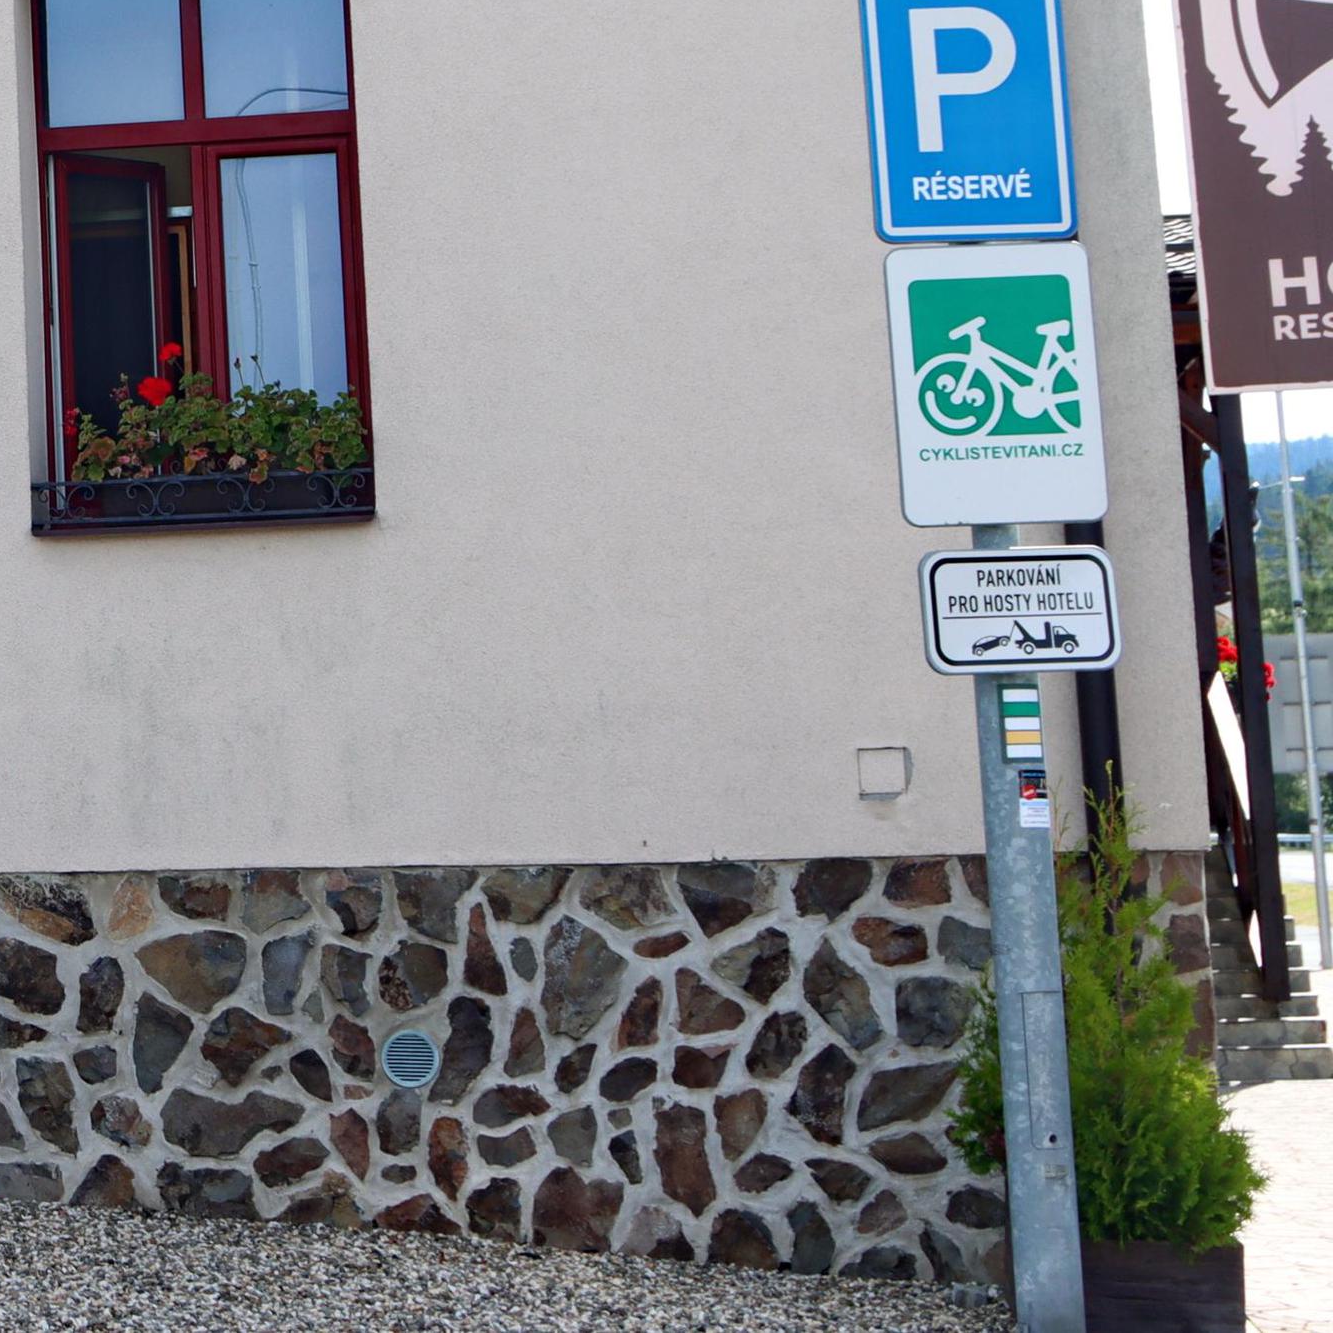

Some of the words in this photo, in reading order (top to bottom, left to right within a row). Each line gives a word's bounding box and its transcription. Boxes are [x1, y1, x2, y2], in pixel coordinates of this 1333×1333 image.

[908, 6, 1017, 153] P
[912, 168, 1032, 201] RÉSERVÉ
[1268, 256, 1333, 307] H
[919, 443, 1084, 462] CYKLISTEVITANI.CZ
[976, 563, 1061, 588] PARKOVÁNÍ
[948, 595, 979, 613] PRO
[984, 593, 1031, 612] HOSTY
[1037, 591, 1094, 611] HOTELU
